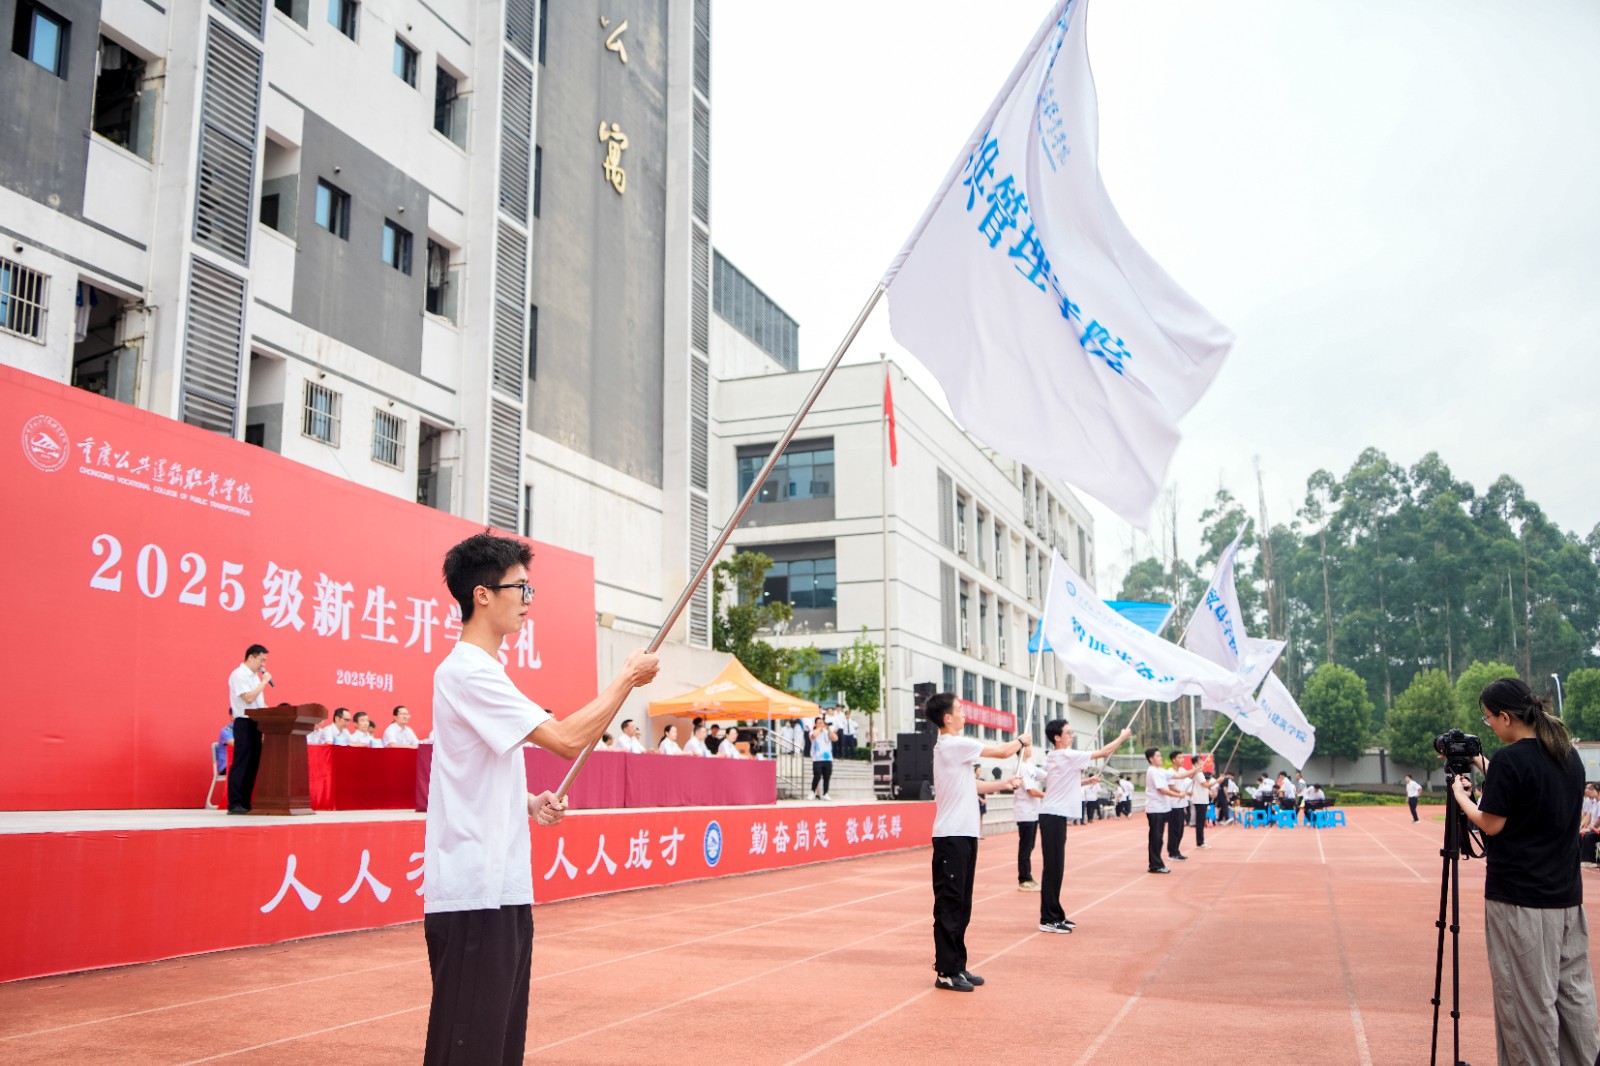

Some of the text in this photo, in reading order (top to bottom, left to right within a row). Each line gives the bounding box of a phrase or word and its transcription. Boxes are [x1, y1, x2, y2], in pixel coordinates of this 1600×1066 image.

[336, 668, 393, 692] 2025年9月
[544, 826, 687, 881] 人人成才
[749, 818, 829, 855] 勤奋尚志
[845, 814, 902, 845] 敬业乐群
